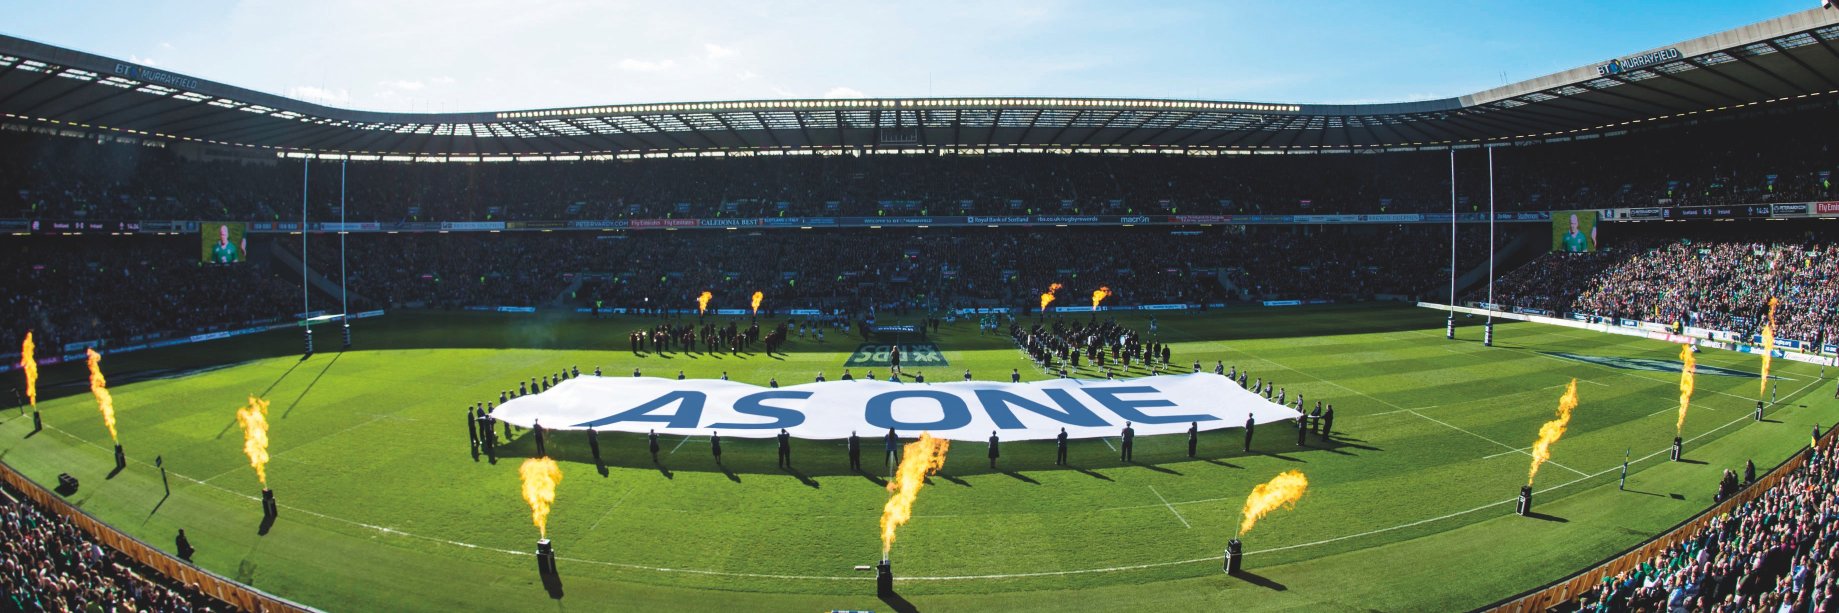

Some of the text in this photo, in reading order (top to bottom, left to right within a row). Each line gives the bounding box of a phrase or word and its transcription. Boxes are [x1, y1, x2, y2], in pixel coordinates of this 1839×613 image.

[1597, 48, 1678, 75] BT MURRAYFIELD
[114, 63, 198, 89] BT MURRAYFIELD
[1818, 203, 1827, 212] Fly
[571, 386, 1222, 431] AS ONE
